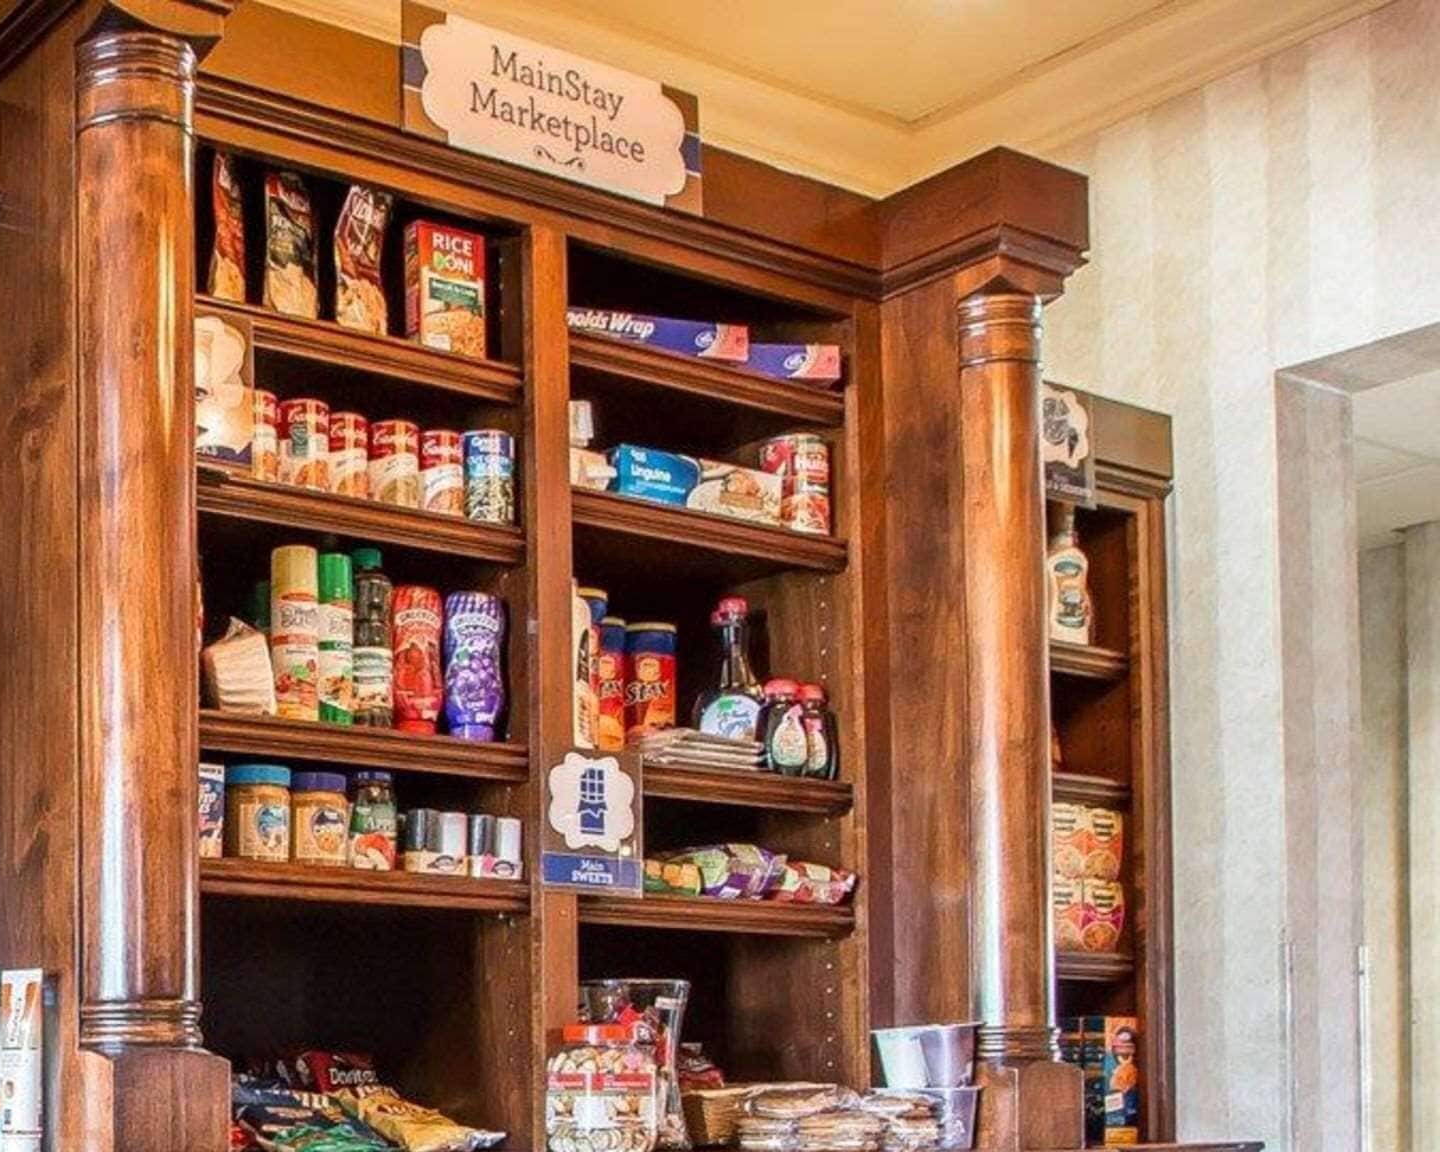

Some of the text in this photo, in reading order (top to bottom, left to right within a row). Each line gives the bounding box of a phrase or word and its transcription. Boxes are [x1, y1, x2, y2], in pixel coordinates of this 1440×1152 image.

[491, 44, 624, 121] MainStay
[469, 82, 646, 163] Marketplace
[432, 231, 473, 257] RICE
[608, 311, 655, 338] Wrap
[570, 870, 614, 885] SWEETS
[579, 859, 605, 872] Main
